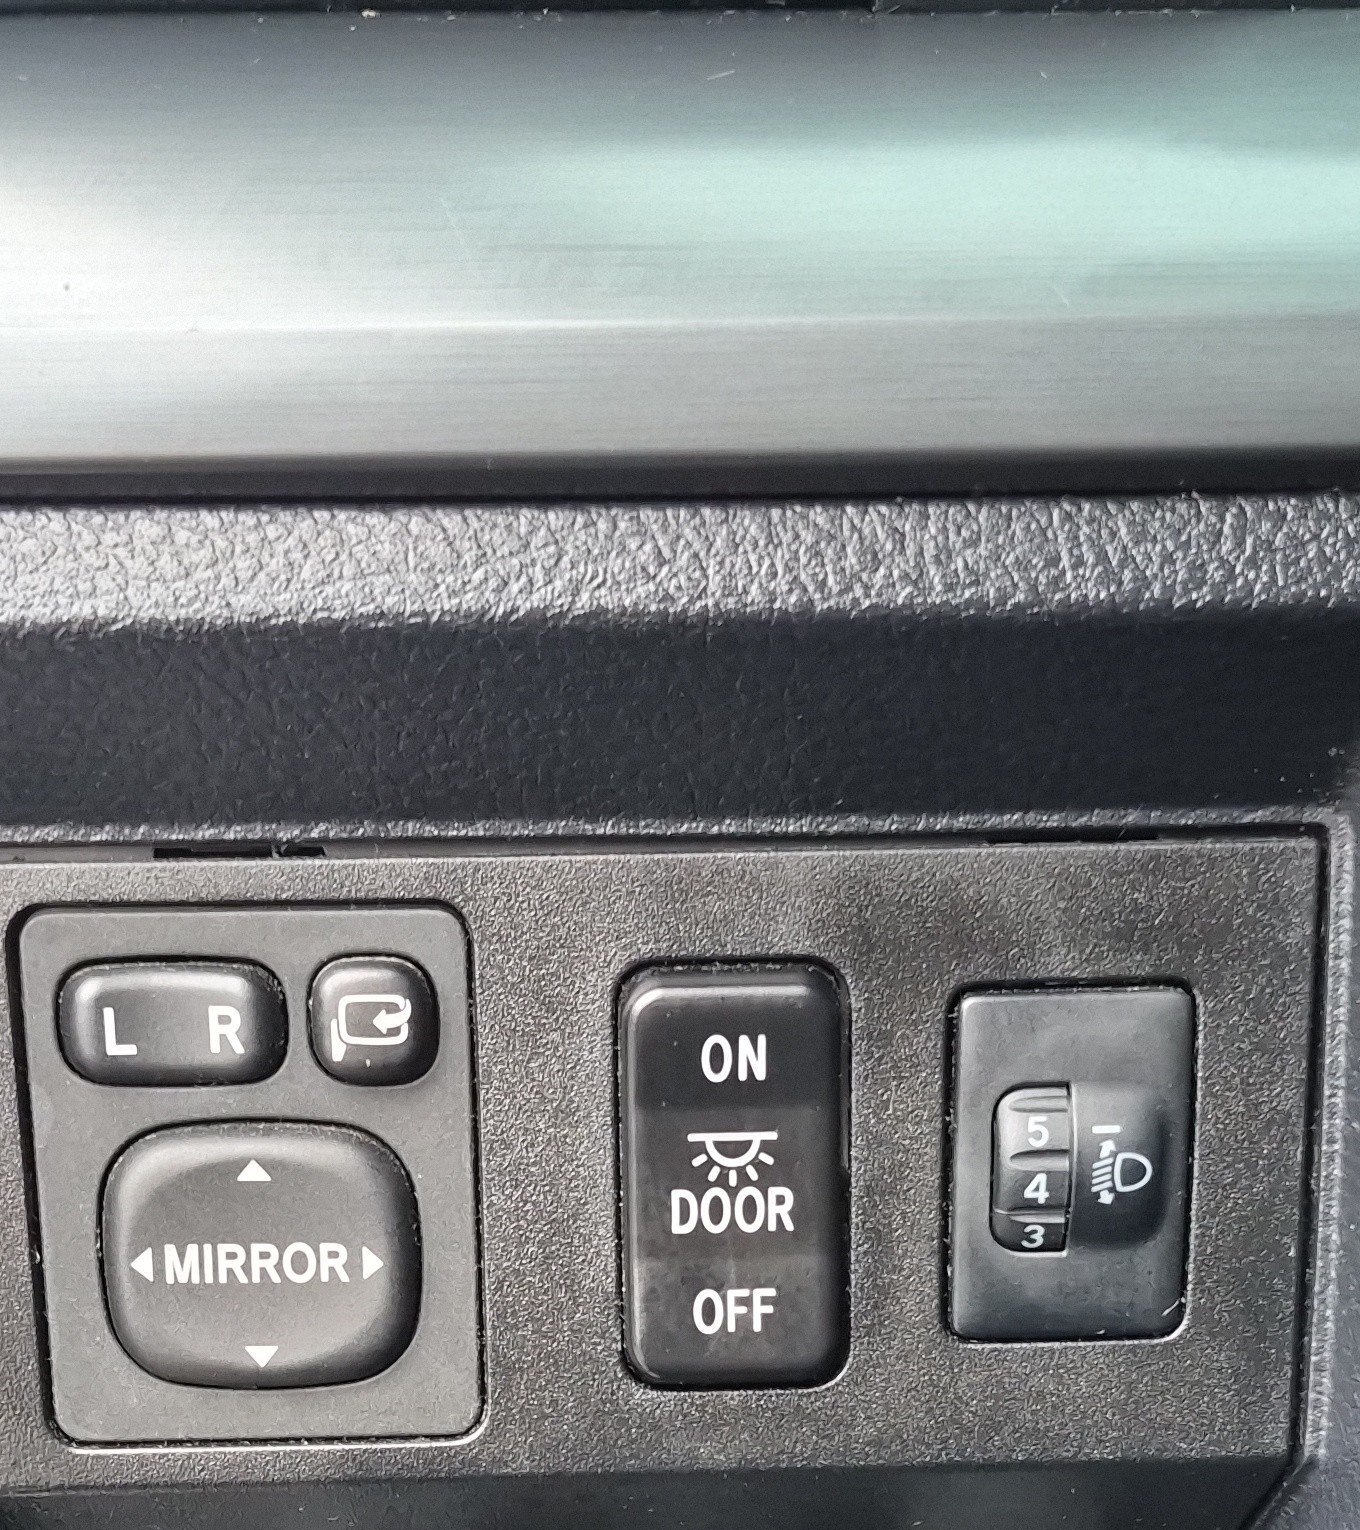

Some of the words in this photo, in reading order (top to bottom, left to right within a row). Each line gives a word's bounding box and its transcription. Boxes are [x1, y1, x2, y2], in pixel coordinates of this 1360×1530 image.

[102, 1006, 138, 1056] L
[207, 1004, 245, 1055] R
[700, 1033, 767, 1083] ON
[1027, 1115, 1051, 1147] 5
[670, 1187, 795, 1235] DOOR
[1023, 1172, 1050, 1205] 4
[1020, 1223, 1045, 1249] 3
[163, 1241, 351, 1285] MIRROR
[692, 1287, 777, 1335] OFF
